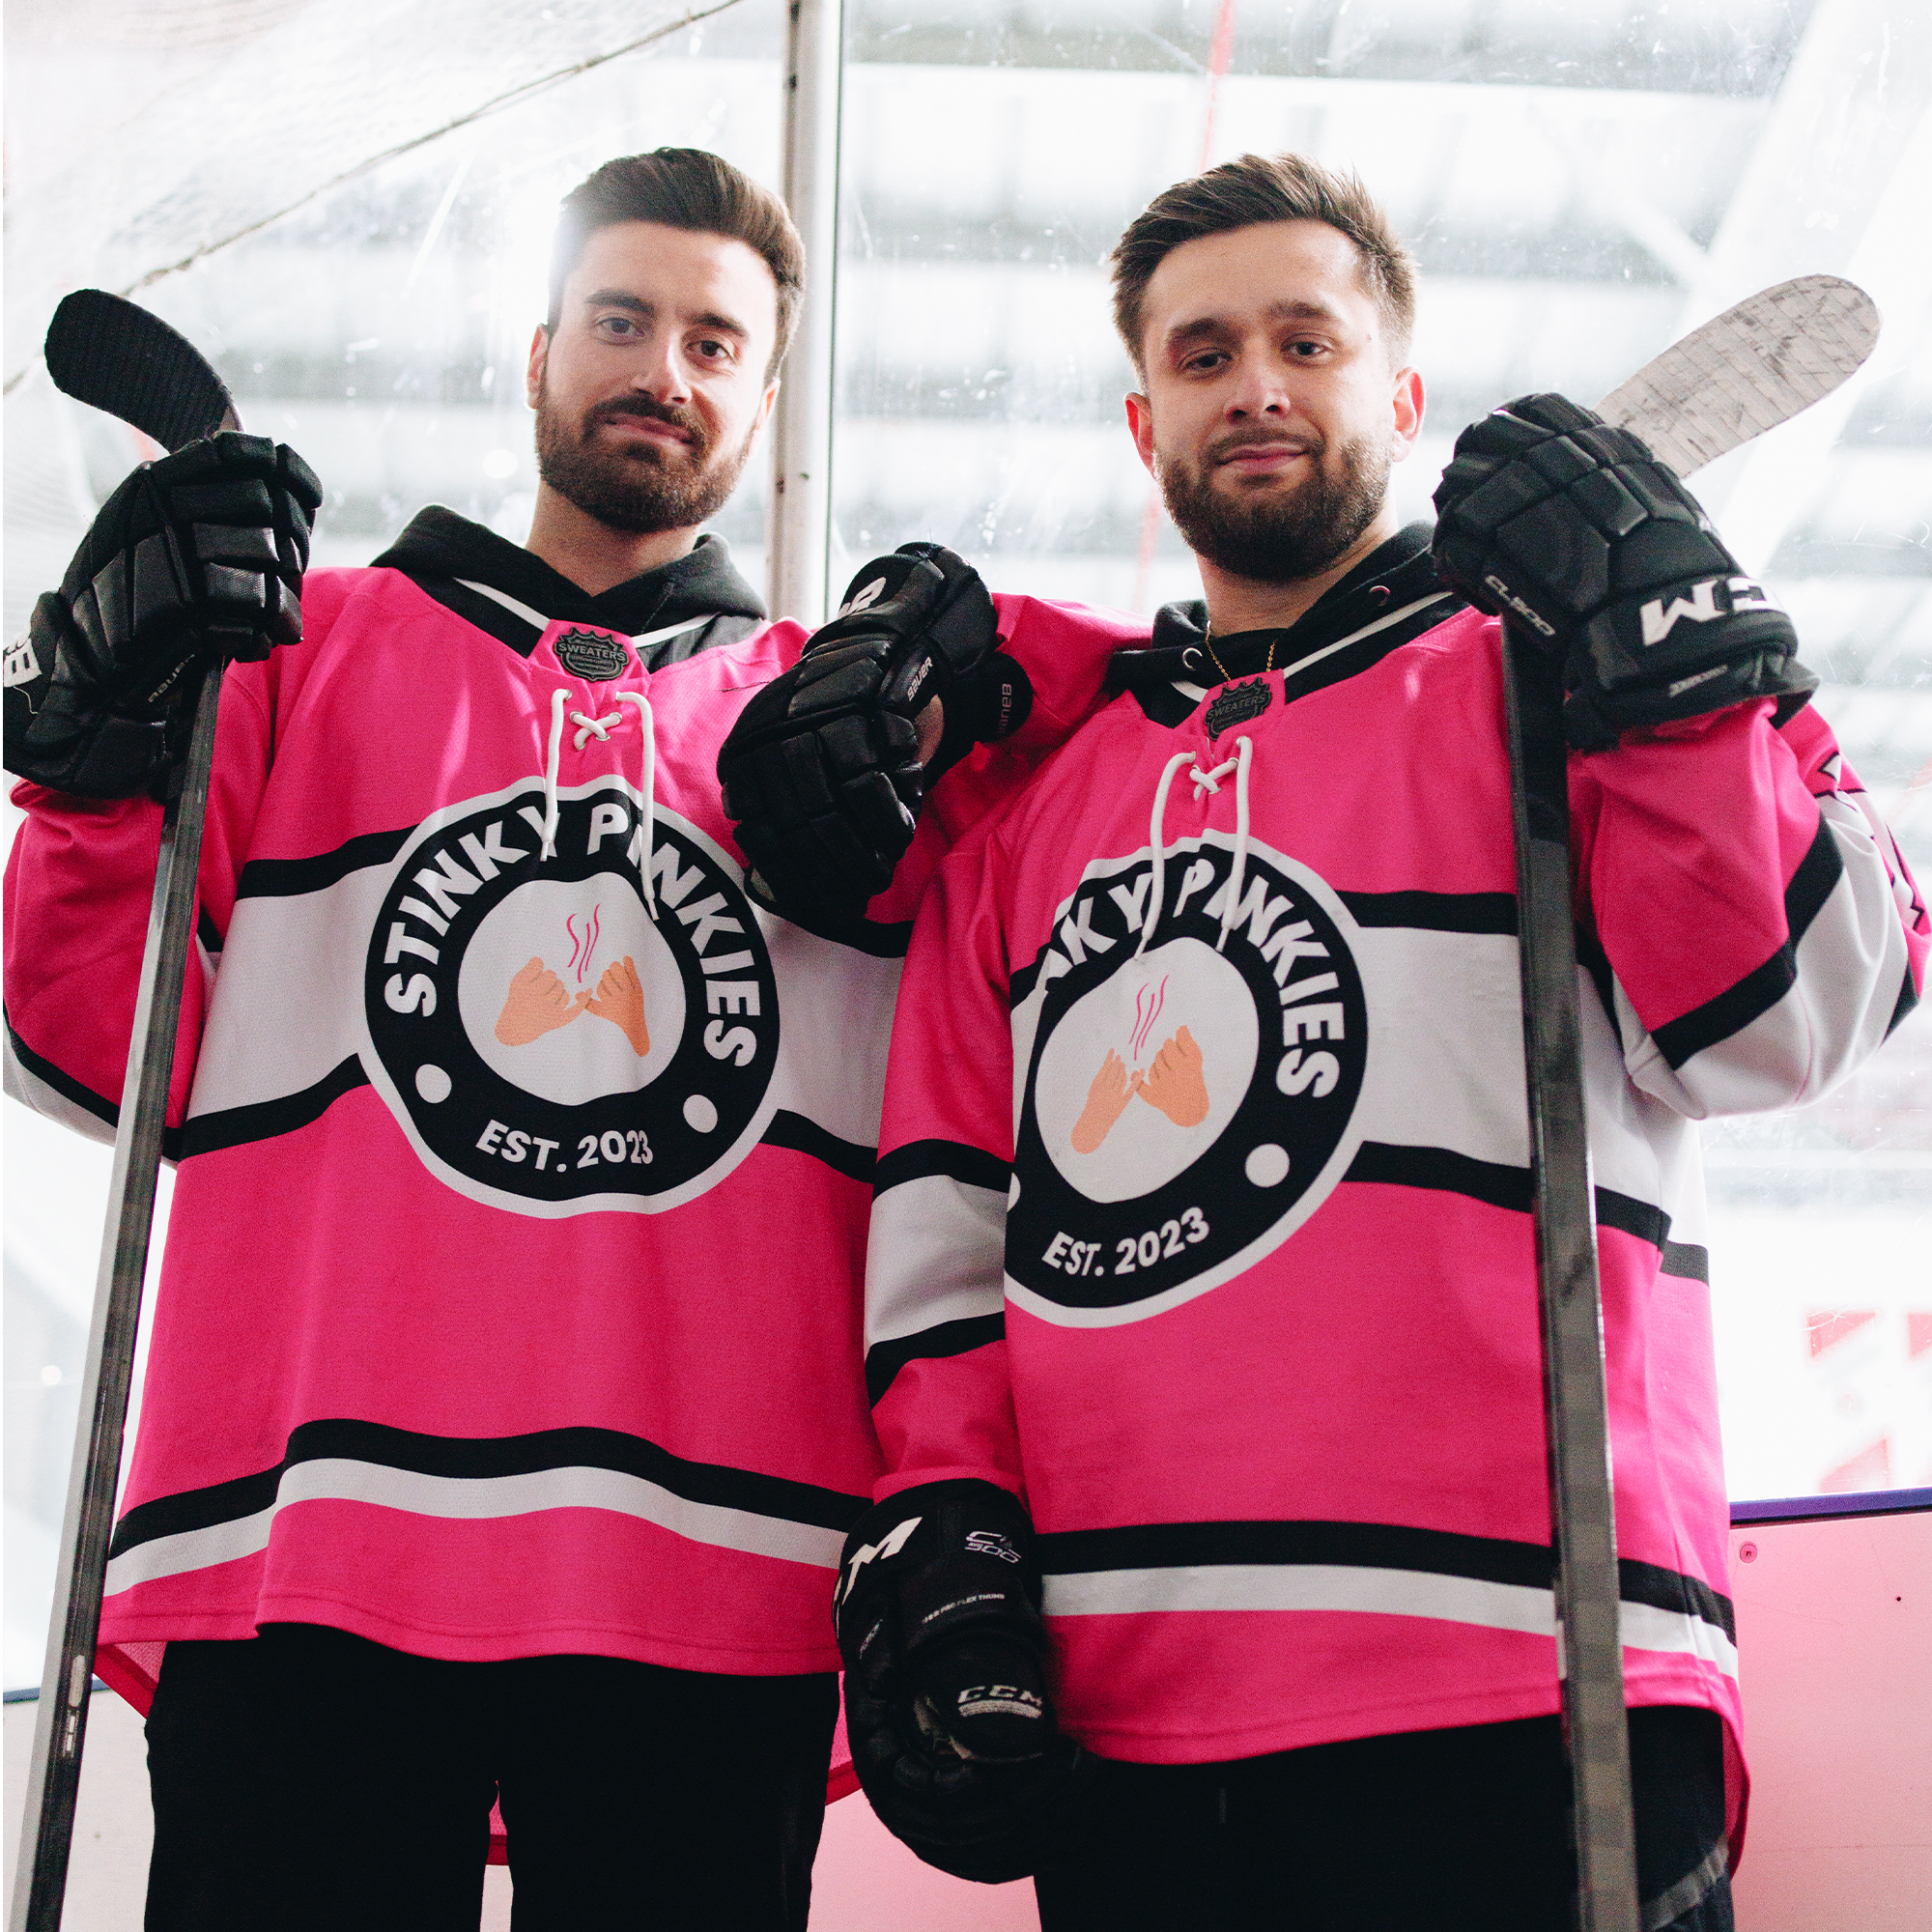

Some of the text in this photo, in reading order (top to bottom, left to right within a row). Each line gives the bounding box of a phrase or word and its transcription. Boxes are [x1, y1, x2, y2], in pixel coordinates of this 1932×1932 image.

[1639, 577, 1789, 647] CM
[557, 641, 627, 662] SWEATERS
[474, 1118, 654, 1173] EST. 2023
[1040, 1206, 1210, 1276] EST. 2023
[956, 1683, 1044, 1708] CCM
